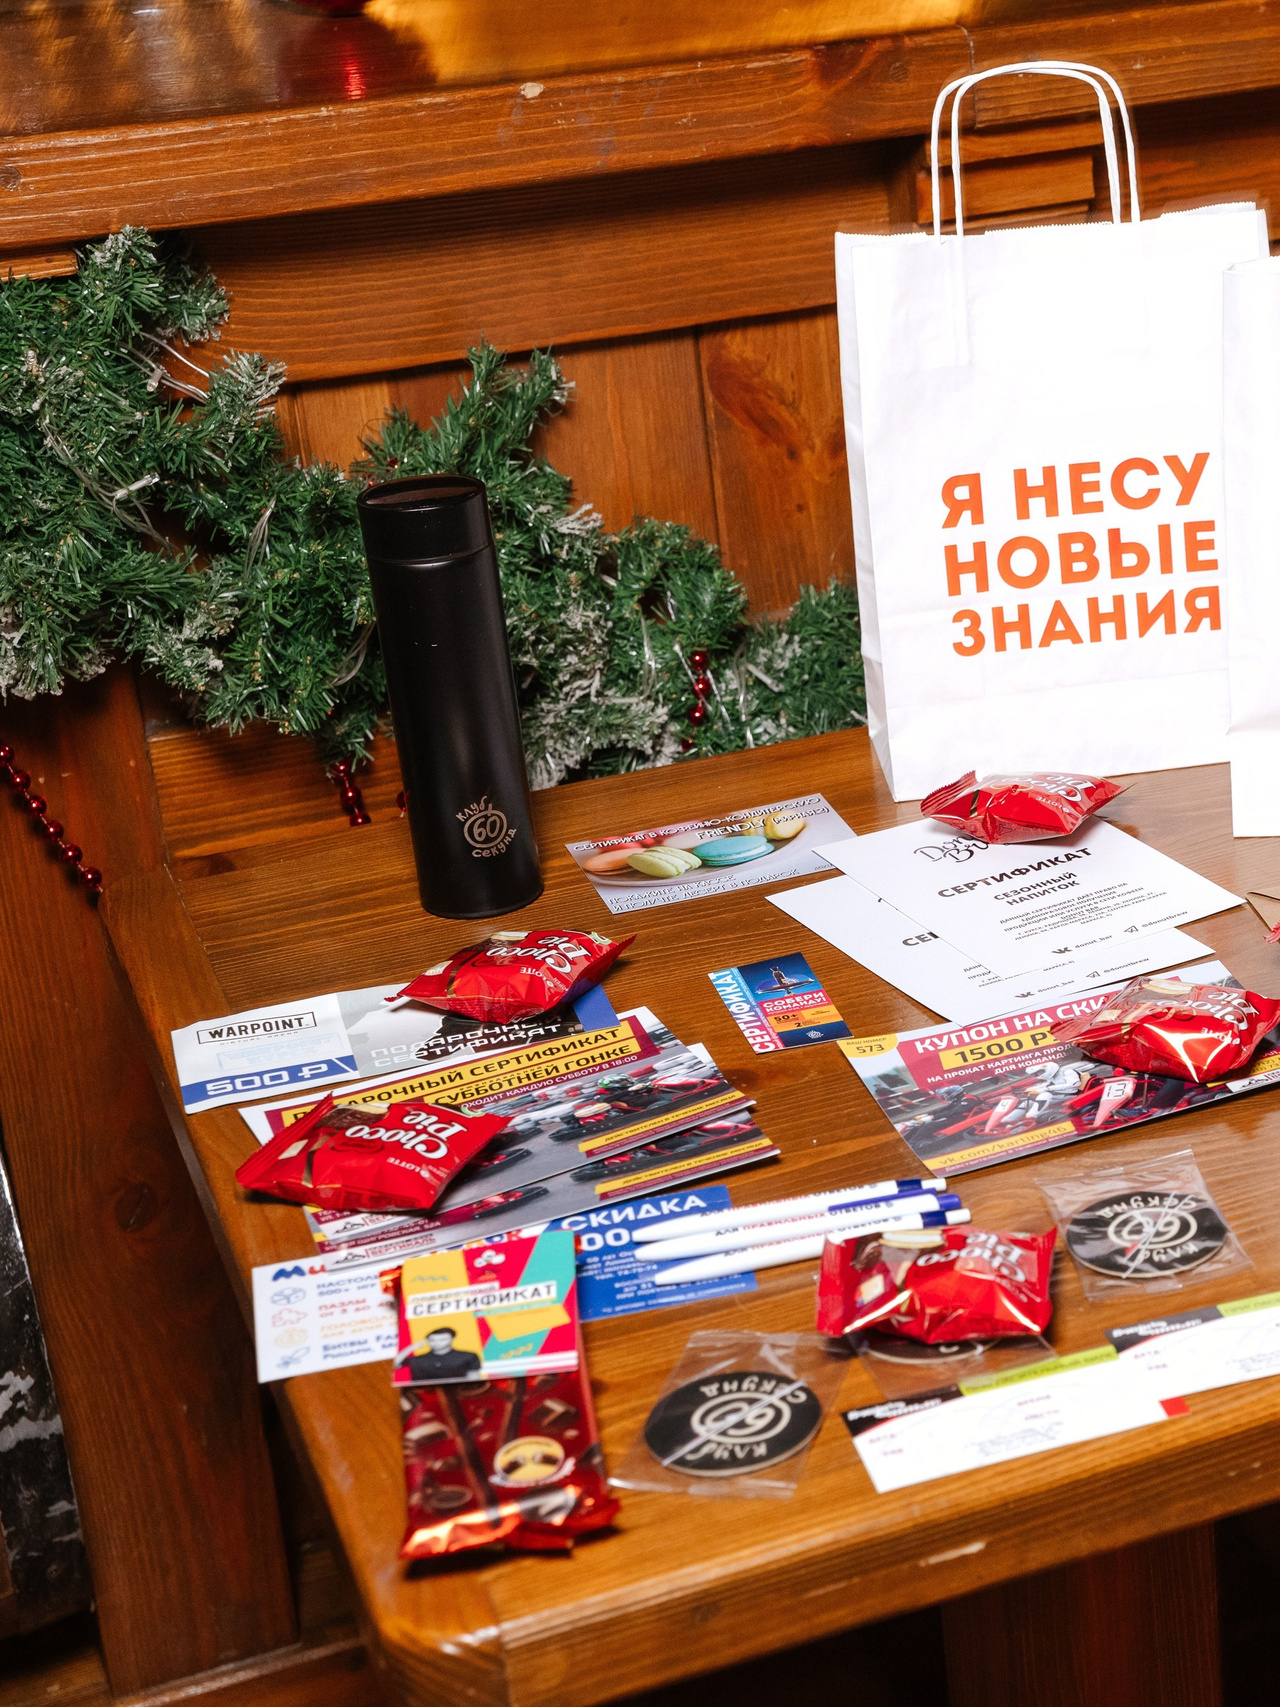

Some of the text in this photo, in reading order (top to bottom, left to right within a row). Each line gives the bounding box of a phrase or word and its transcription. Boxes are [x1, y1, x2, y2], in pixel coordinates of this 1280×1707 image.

[941, 452, 1211, 529] Я НЕСУ
[943, 519, 1219, 597] НОВЫЕ
[951, 585, 1222, 657] ЗНАНИЯ
[473, 815, 500, 842] 60
[695, 818, 767, 840] FRIENDLY
[937, 847, 1092, 898] СЕРТИФИКАТ
[993, 871, 1078, 901] СЕЗОННЫЙ
[1006, 880, 1081, 906] НАПИТОК
[485, 935, 592, 975] Choco Pie
[711, 969, 776, 1054] СЕРТИФИКАТ
[762, 991, 825, 1008] СОБЕРИ
[1156, 990, 1260, 1031] Choco Pie
[208, 1017, 305, 1040] WARPOINT
[373, 1023, 562, 1068] СЕРТИФИКАТ
[913, 1021, 1010, 1055] КУПОН
[1013, 1011, 1054, 1030] НА
[469, 1028, 620, 1077] СЕРТИФИКАТ
[855, 1043, 885, 1055] 573
[926, 1051, 1038, 1084] НА ПРОКАТ КАРТИНГА
[954, 1037, 1025, 1064] 1500
[205, 1070, 290, 1096] 500
[434, 1044, 633, 1105] СУББОТНЕЙ ГОНКЕ
[505, 1079, 555, 1098] КАЖДУЮ
[554, 1063, 601, 1084] СУББОТУ
[610, 1053, 638, 1068] 18:00
[994, 1063, 1017, 1076] ДЛЯ
[344, 1110, 469, 1160] Choco Pie
[386, 1156, 424, 1173] LOTTE
[560, 1194, 708, 1232] СКИДКА
[715, 1226, 741, 1237] ДЛЯ
[741, 1211, 826, 1232] ПРАВИЛЬНЫХ
[915, 1231, 1026, 1283] Choco Pie
[412, 1284, 555, 1317] СЕРТИФИКАТ
